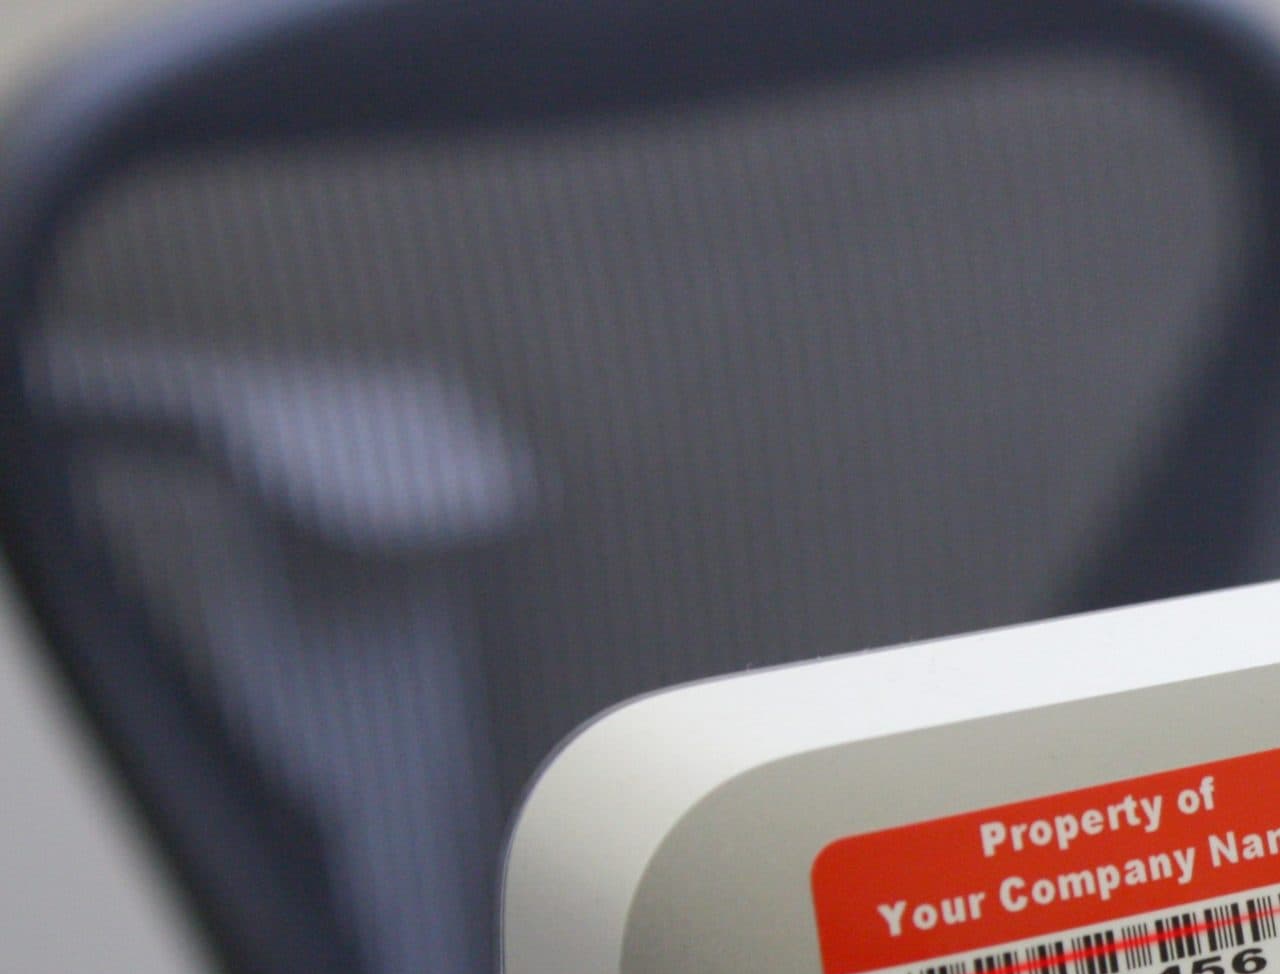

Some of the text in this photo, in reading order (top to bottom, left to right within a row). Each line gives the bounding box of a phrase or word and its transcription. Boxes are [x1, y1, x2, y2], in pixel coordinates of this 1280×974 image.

[981, 777, 1215, 856] Property of
[878, 891, 985, 935] Your
[1000, 847, 1196, 912] Company
